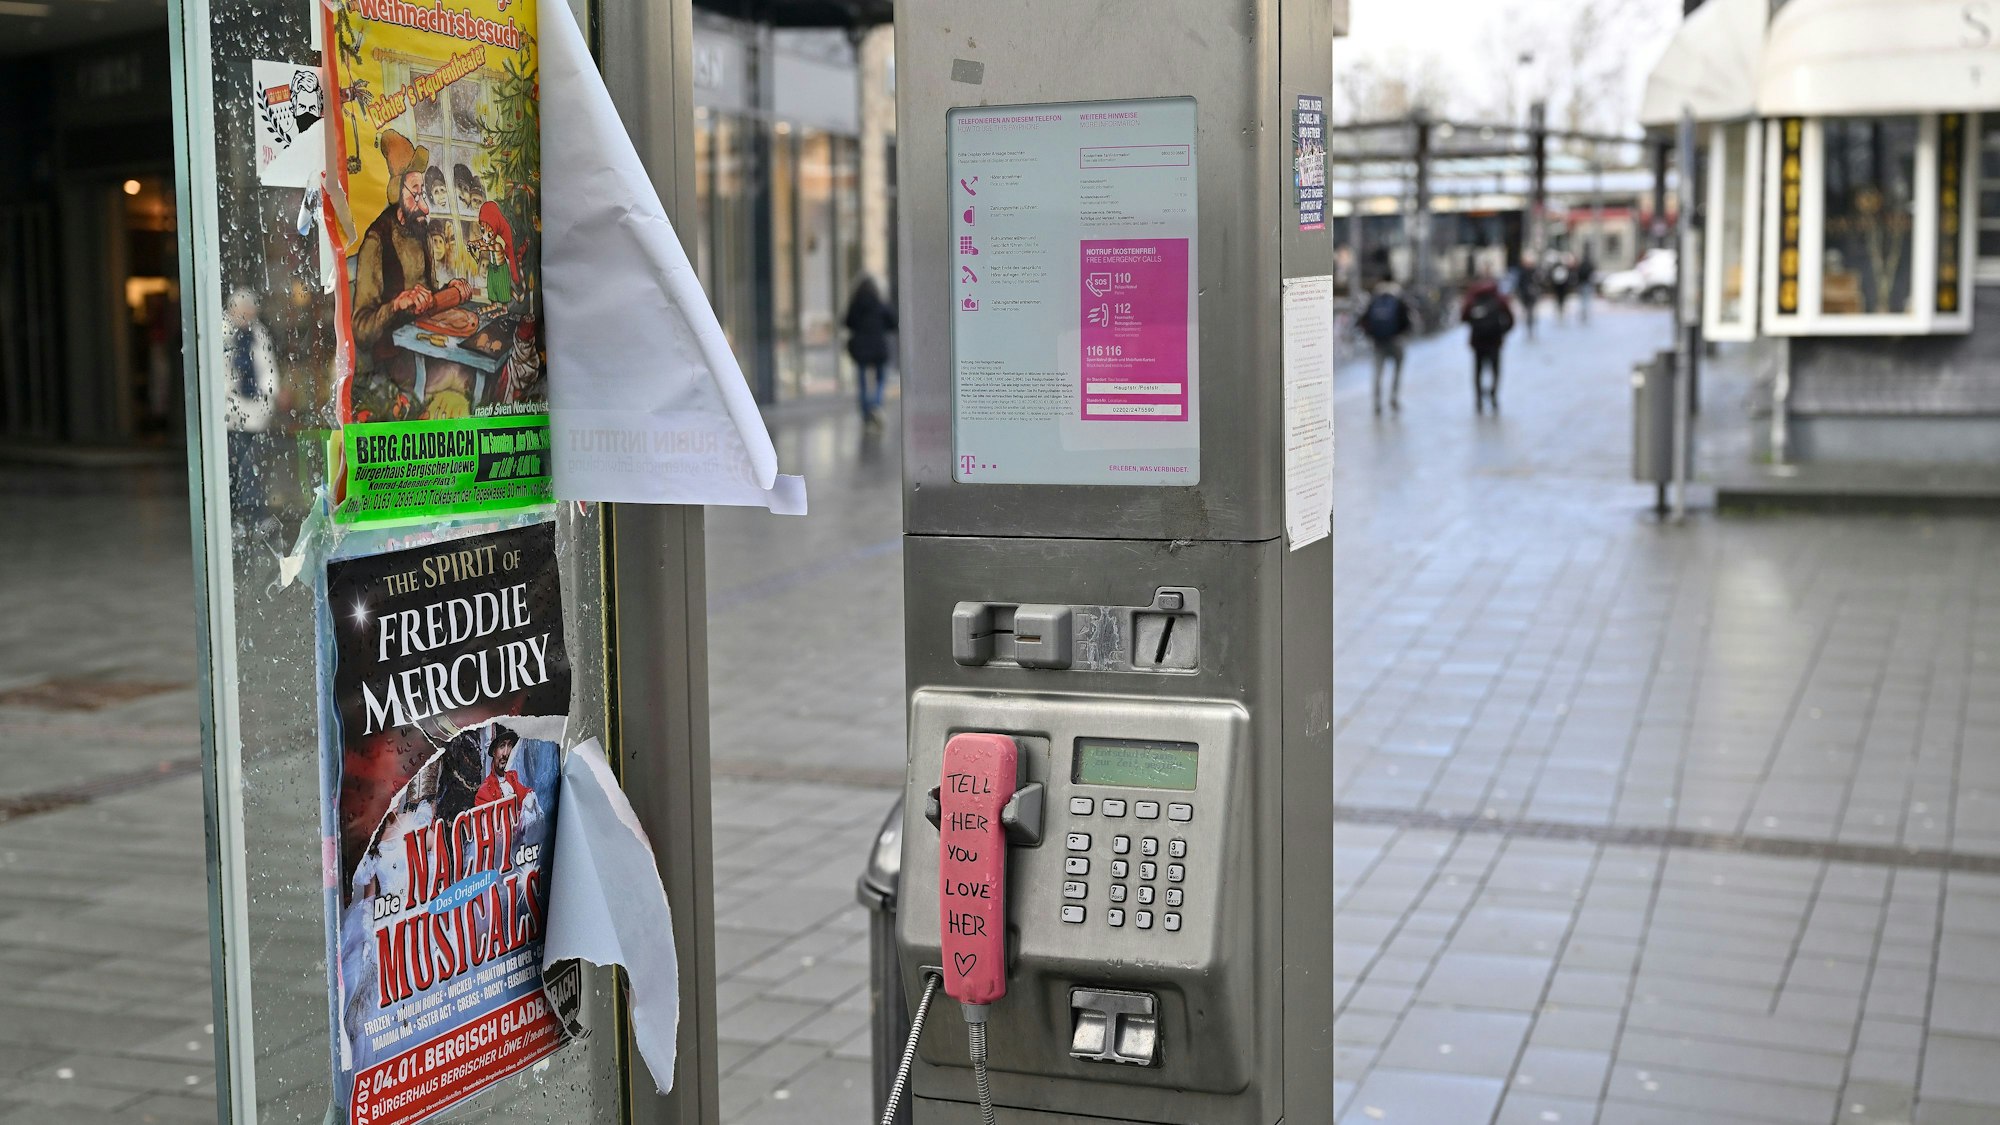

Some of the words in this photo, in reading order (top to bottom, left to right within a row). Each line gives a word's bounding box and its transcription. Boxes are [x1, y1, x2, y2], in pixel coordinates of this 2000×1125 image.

[358, 0, 520, 49] Weihnachtsbesuch
[413, 44, 486, 103] Figurentheater
[1112, 247, 1156, 255] (KOSTENFREI)
[1114, 273, 1131, 283] 110
[1114, 303, 1131, 314] 112
[1086, 345, 1103, 356] 116
[1105, 345, 1122, 356] 116
[474, 402, 493, 416] nach
[494, 402, 513, 415] Sven
[513, 401, 549, 416] Nordqvist
[356, 430, 475, 464] BERG.GLADBACH
[354, 465, 405, 482] Bürgerhaus
[406, 463, 449, 478] Bergischer
[450, 460, 475, 474] Loewe
[368, 479, 450, 491] Konrad-Adenauer-Platz
[428, 489, 450, 504] Tickets
[461, 488, 472, 502] der
[473, 486, 506, 506] Tageskasse
[383, 569, 420, 597] THE
[422, 544, 498, 589] SPIRIT
[502, 550, 522, 571] OF
[377, 582, 531, 663] FREDDIE
[362, 632, 550, 736] MERCURY
[947, 774, 992, 794] TELL
[951, 812, 989, 833] HER
[947, 844, 978, 863] YOU
[1143, 841, 1148, 849] 2
[373, 893, 400, 921] Die
[403, 795, 520, 911] NACHT
[515, 844, 540, 867] der
[436, 896, 453, 912] Das
[454, 876, 492, 902] Original!
[946, 879, 991, 899] LOVE
[949, 910, 987, 937] HER
[1137, 913, 1142, 922] 0
[375, 867, 542, 1008] MUSICALS
[364, 1014, 391, 1036] FROZEN
[396, 1000, 422, 1022] MOULIN
[422, 990, 444, 1010] ROUGE
[447, 977, 472, 999] WICKED
[476, 963, 506, 986] PHANTOM
[506, 957, 518, 973] DER
[518, 950, 533, 968] OPER
[372, 1027, 400, 1052] MAMMA
[400, 1022, 413, 1039] MIA
[416, 1009, 440, 1031] SISTER
[440, 1003, 452, 1021] ACT
[457, 991, 480, 1012] GREASE
[483, 980, 504, 1000] ROCKY
[508, 965, 536, 989] ELISABETH
[372, 1053, 423, 1095] 04.01.
[425, 1018, 498, 1072] BERGISCH
[372, 1076, 438, 1120] BÜRGERHAUS
[440, 1048, 497, 1088] BERGISCHER
[498, 1036, 522, 1059] LÖWE
